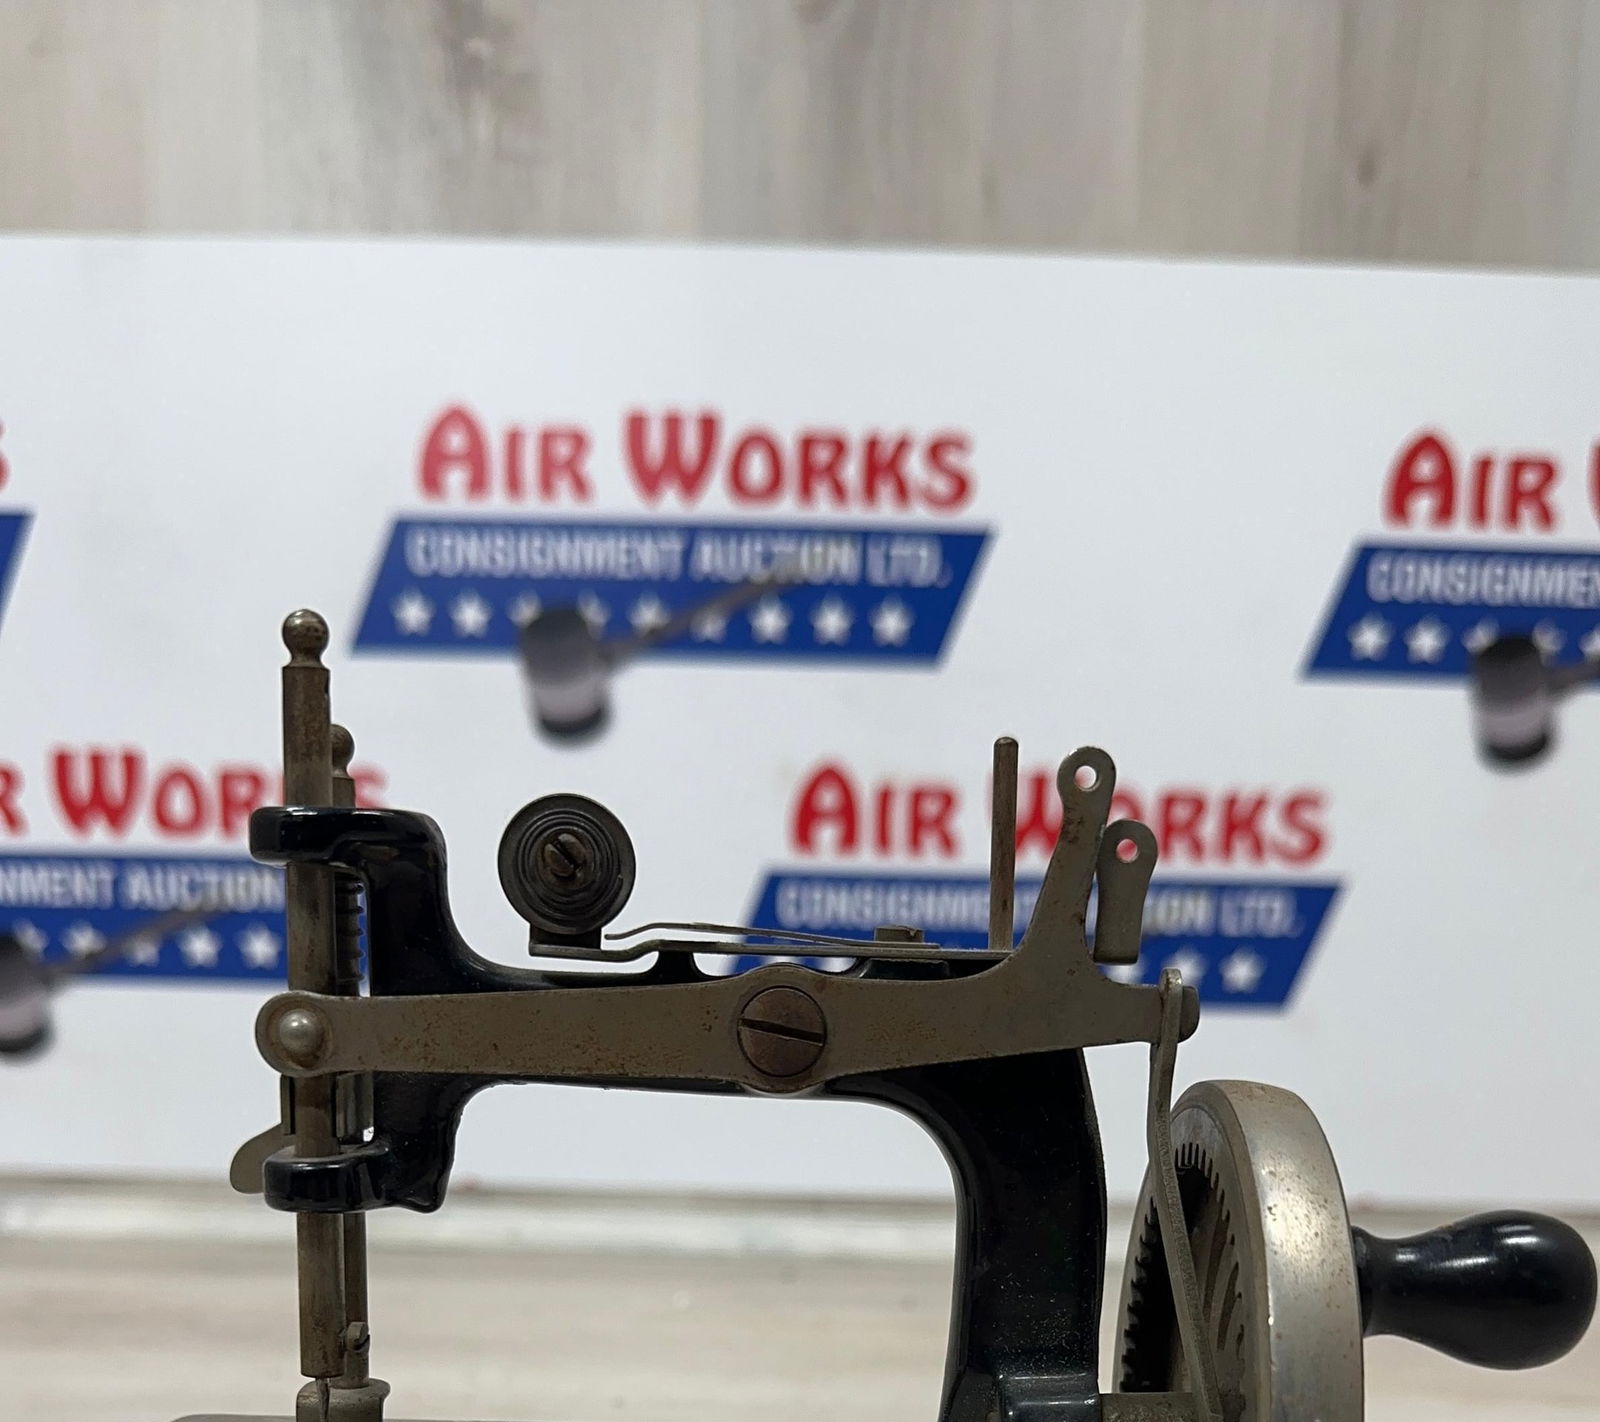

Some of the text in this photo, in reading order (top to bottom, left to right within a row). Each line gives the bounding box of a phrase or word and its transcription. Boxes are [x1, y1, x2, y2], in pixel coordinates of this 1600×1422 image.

[406, 528, 952, 588] CONSIGNMENT AUCTION LTD.
